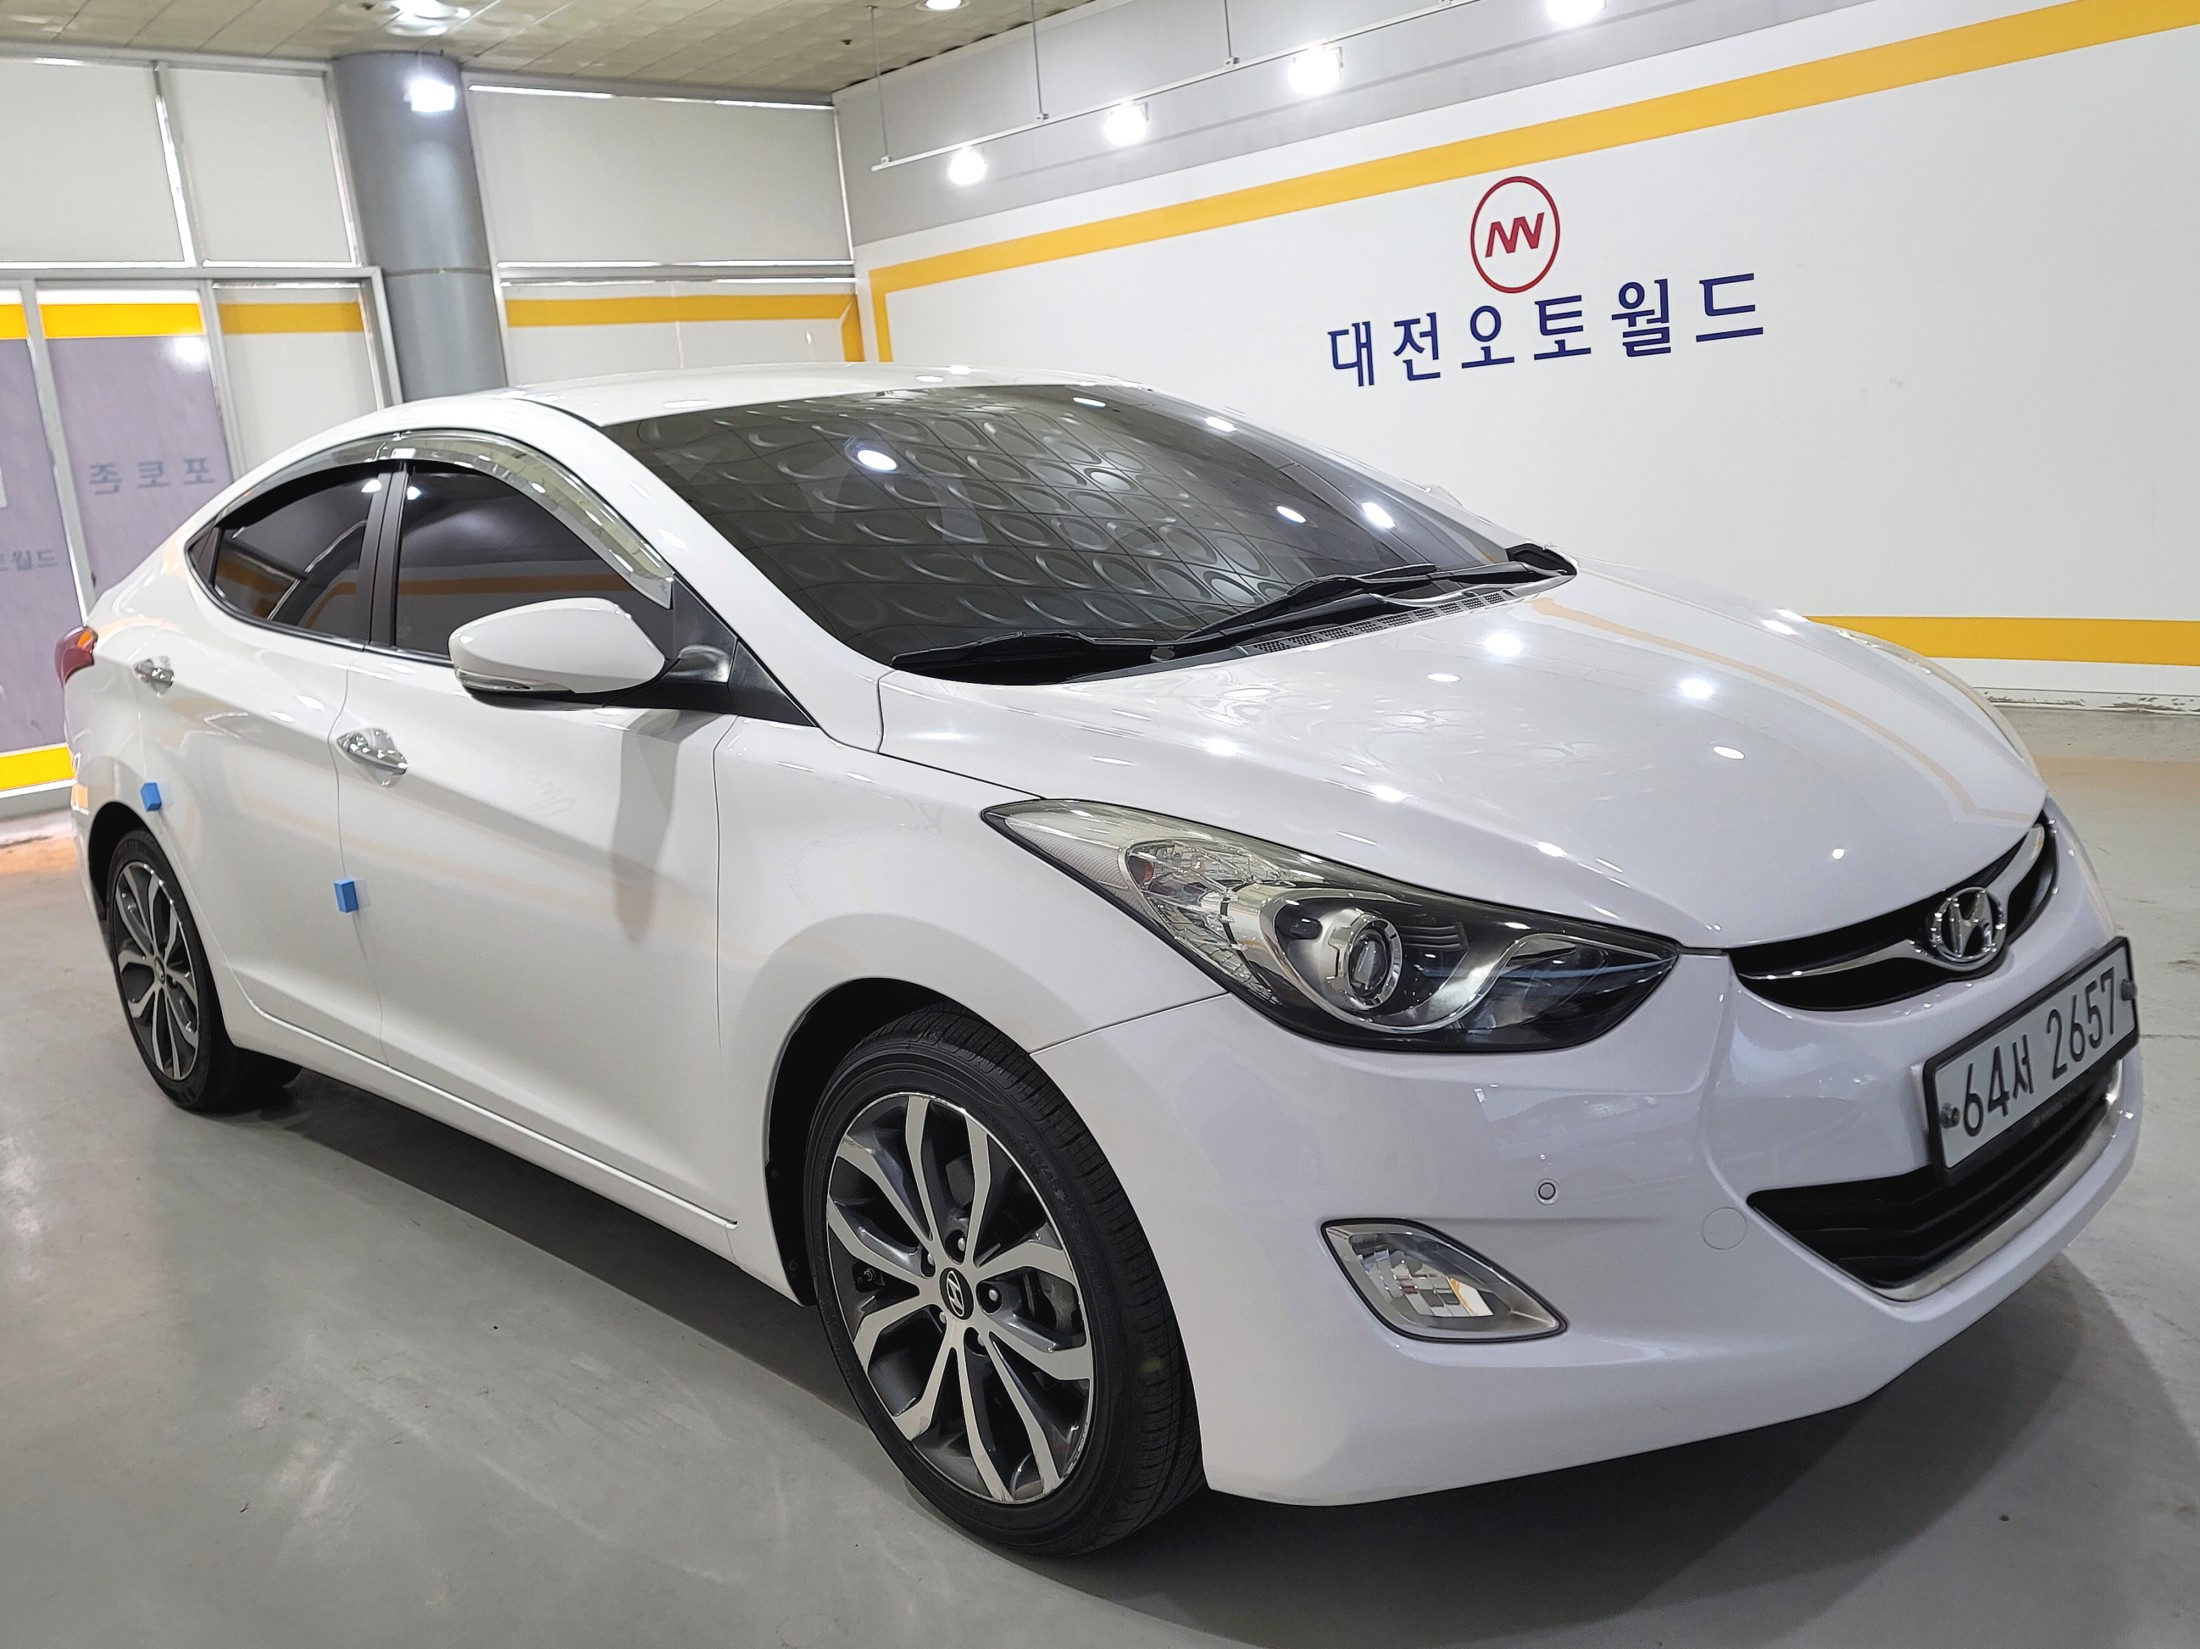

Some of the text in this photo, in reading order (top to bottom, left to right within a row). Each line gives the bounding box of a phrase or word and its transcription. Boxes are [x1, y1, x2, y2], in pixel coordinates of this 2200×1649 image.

[1327, 273, 1764, 388] 대전오토월드
[1963, 966, 2115, 1138] 64서 2657
